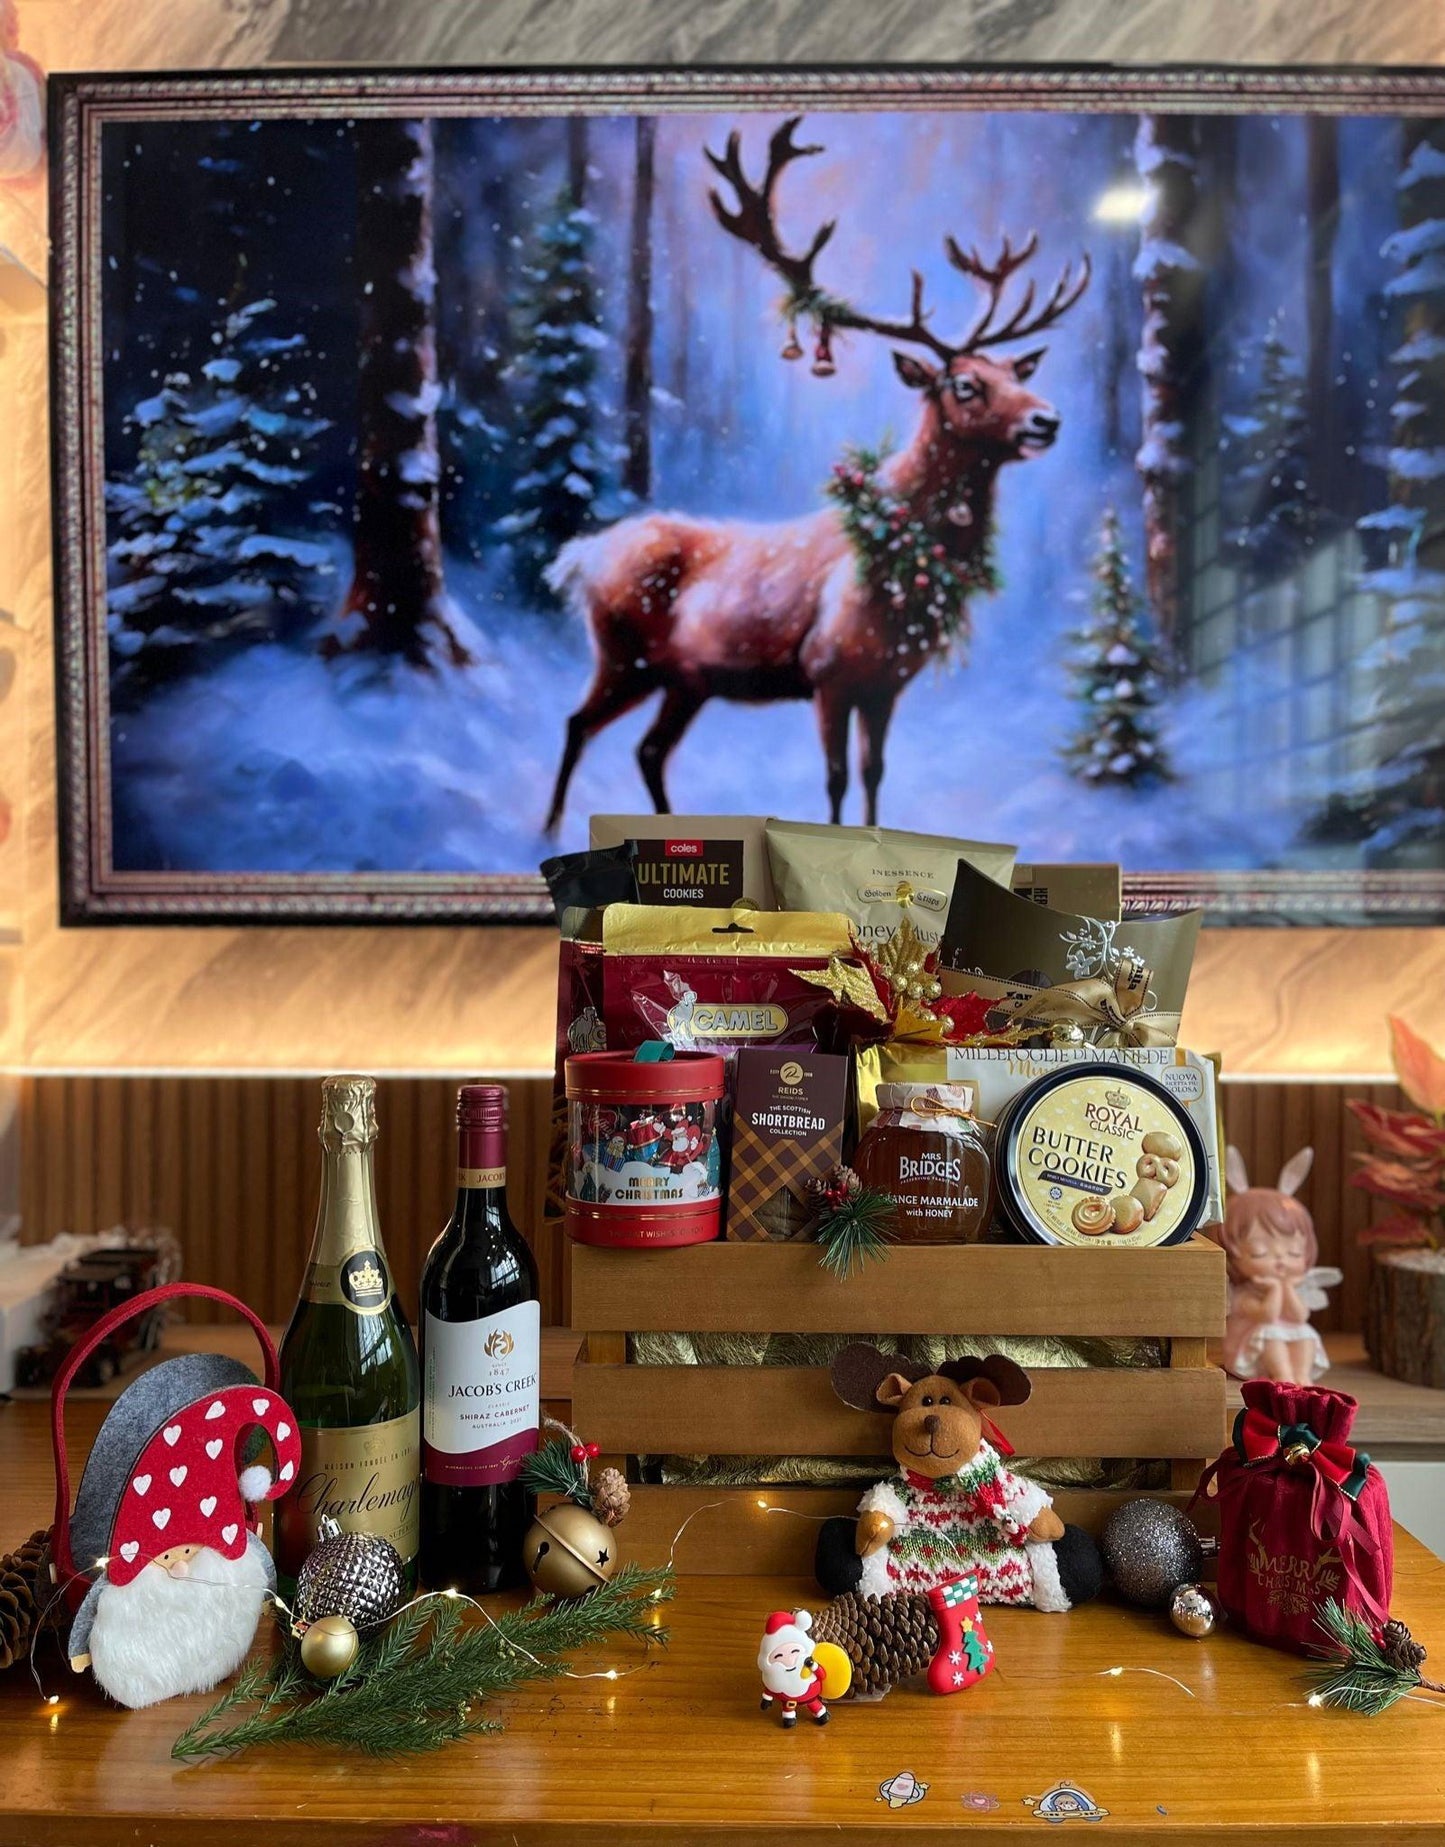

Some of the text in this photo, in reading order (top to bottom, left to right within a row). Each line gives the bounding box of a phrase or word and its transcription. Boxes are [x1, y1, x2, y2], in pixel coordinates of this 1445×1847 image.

[670, 843, 698, 853] coles
[638, 863, 729, 885] ULTIMATE
[872, 868, 934, 879] INESSENCE
[663, 888, 704, 899] COOKIES
[857, 924, 940, 945] oney Must
[694, 1009, 778, 1031] CAMEL
[954, 1048, 1069, 1063] MILLEFOGLIE
[1073, 1048, 1087, 1060] DI
[1165, 1073, 1197, 1081] NUOVA
[778, 1086, 804, 1096] REIDS
[782, 1105, 811, 1115] SCOTTISH
[751, 1112, 826, 1131] SHORTBREAD
[1084, 1102, 1143, 1133] ROYAL
[769, 1128, 807, 1137] COLLECTION
[1089, 1120, 1135, 1141] CLASSIC
[1032, 1126, 1114, 1164] BUTTER
[921, 1152, 941, 1160] MRS
[899, 1156, 961, 1182] BRIDGES
[1028, 1147, 1128, 1189] COOKIES
[629, 1177, 670, 1187] MERRY
[615, 1188, 684, 1200] CHRISTMAS
[920, 1196, 979, 1207] MARMALADE
[906, 1208, 953, 1218] with HONEY
[489, 1368, 510, 1377] 1847
[448, 1373, 537, 1398] JACOB'S CREEK
[460, 1404, 530, 1421] SHIRAZ CABERNET
[472, 1421, 506, 1429] AUSTRALIA
[296, 1472, 418, 1521] Charlemag
